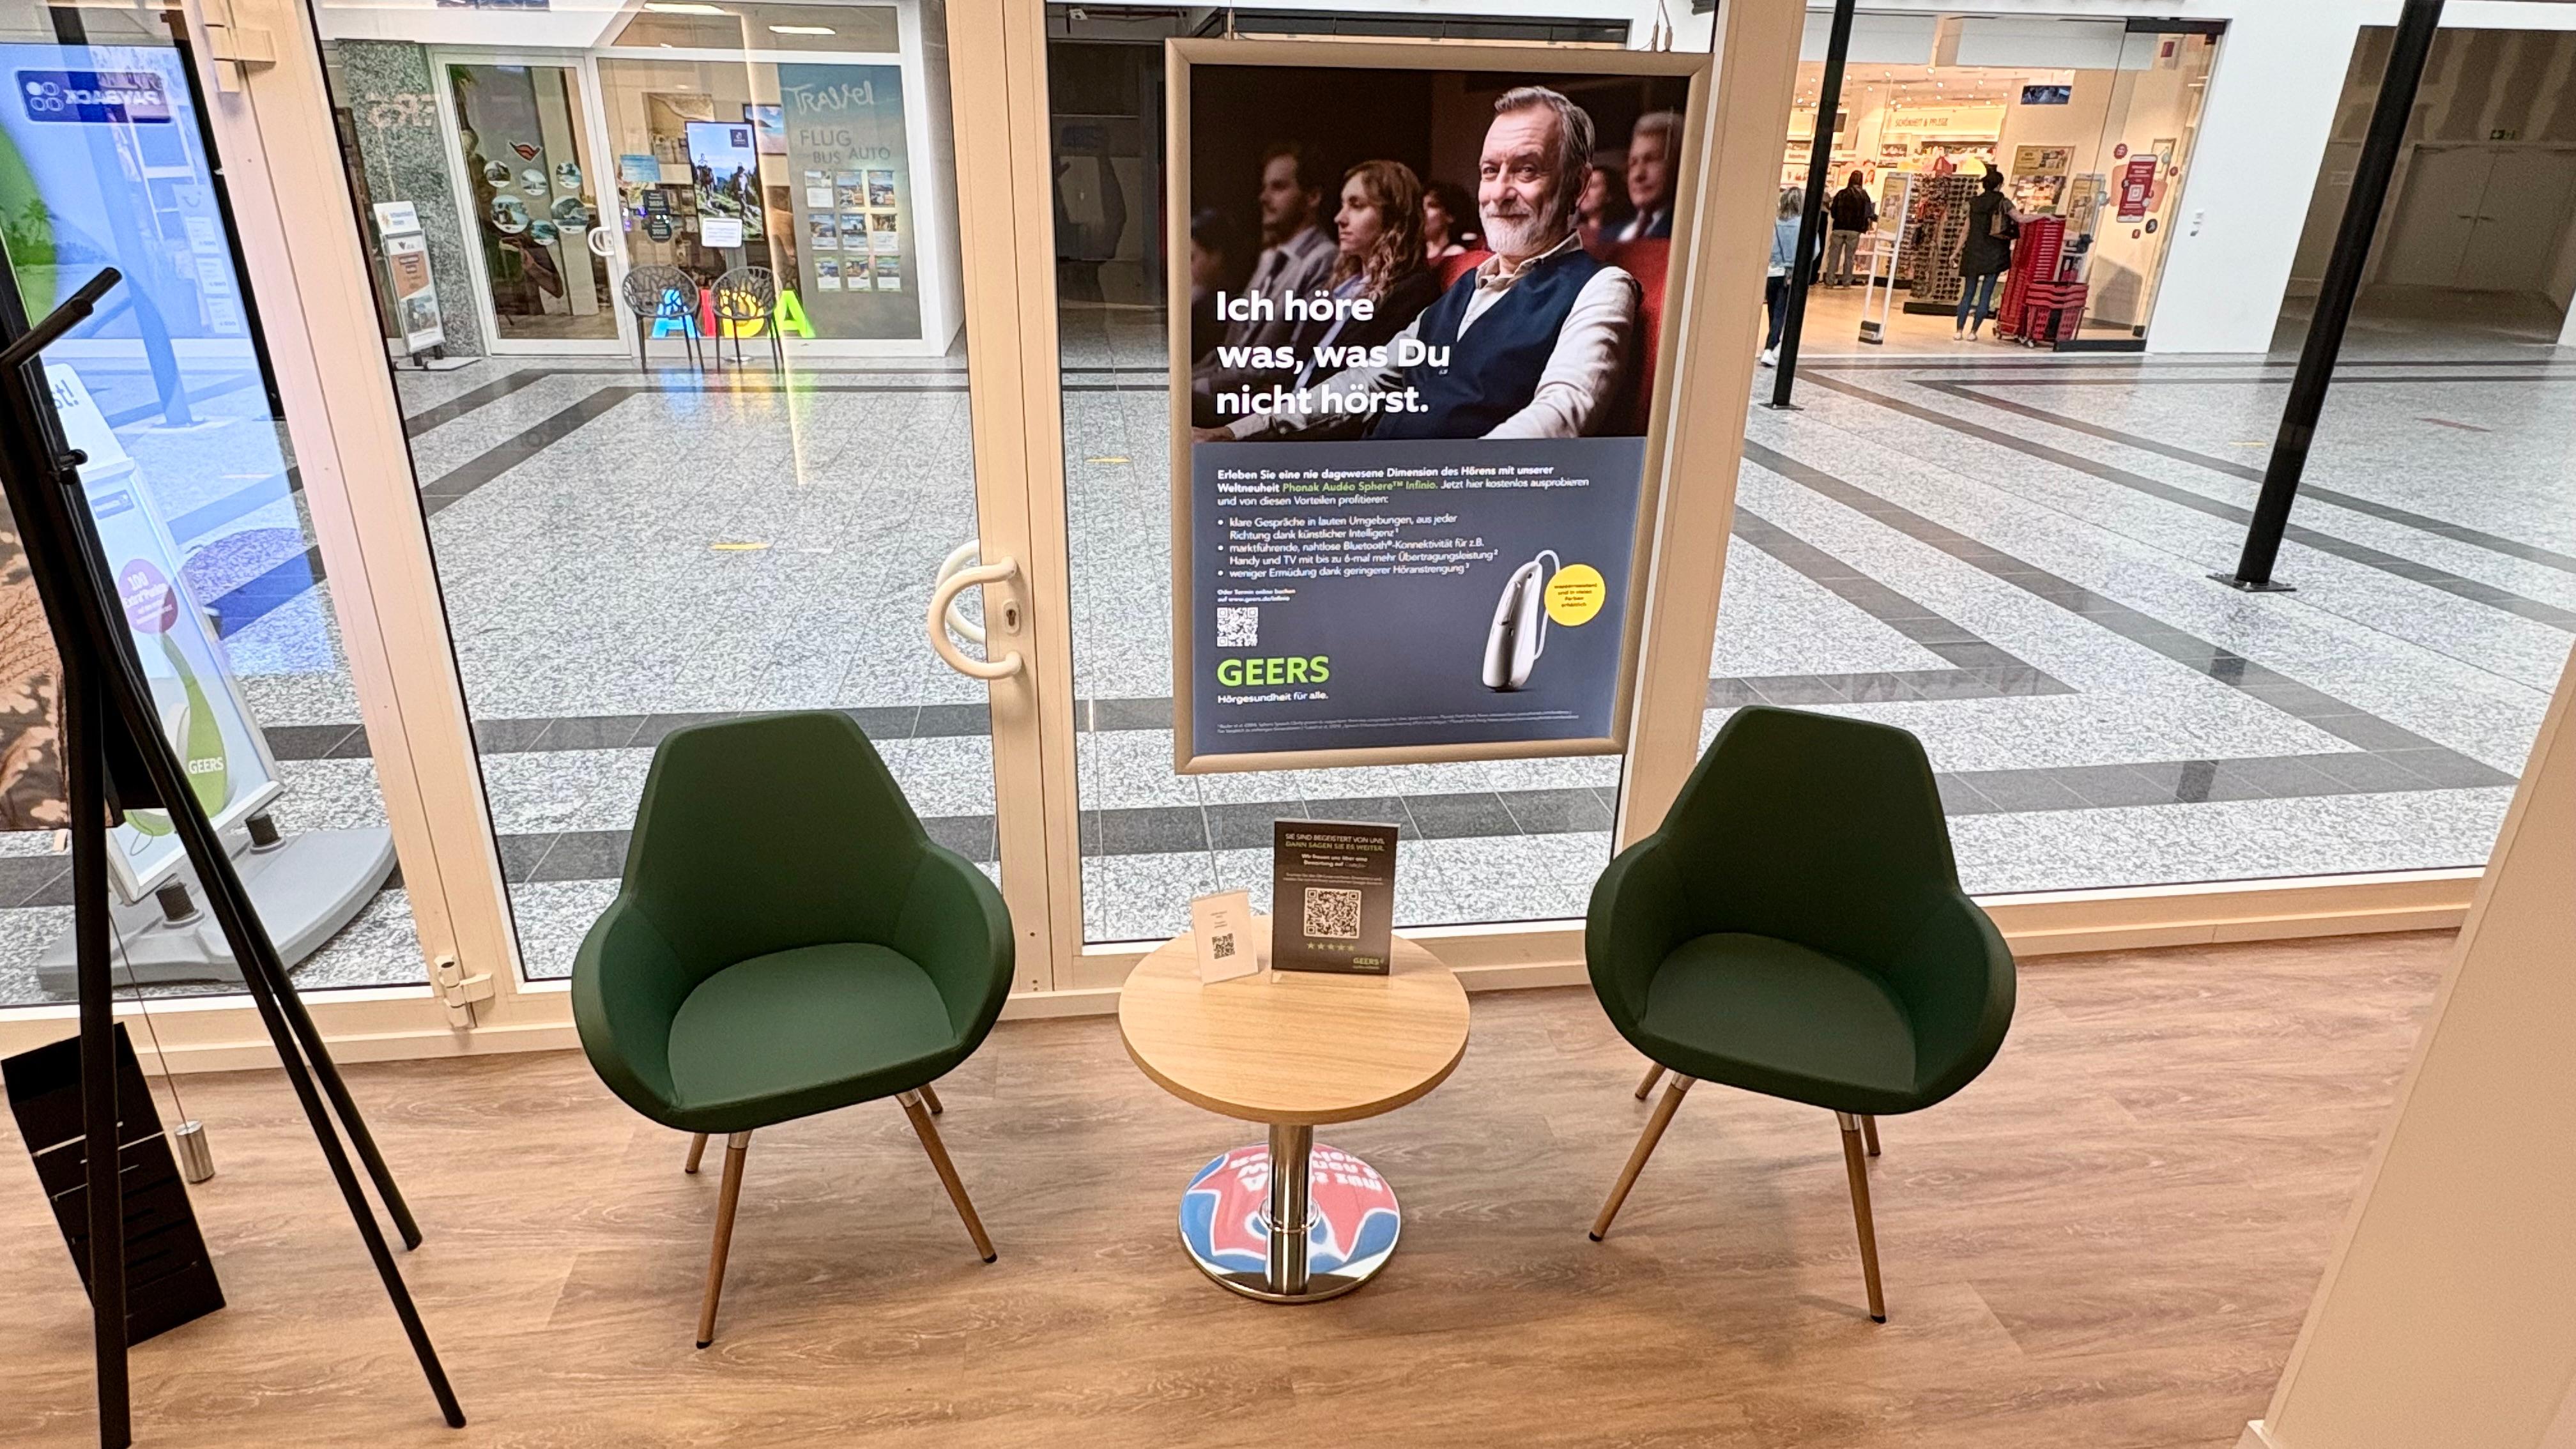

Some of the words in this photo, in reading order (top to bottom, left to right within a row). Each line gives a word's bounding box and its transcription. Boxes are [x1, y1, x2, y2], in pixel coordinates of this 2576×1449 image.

[800, 129, 852, 147] FLUG
[813, 151, 841, 164] BUS
[848, 148, 891, 160] AUTO
[1216, 289, 1274, 321] Ich
[1285, 290, 1375, 321] höre
[1217, 344, 1304, 375] was,
[1313, 345, 1389, 369] was
[1399, 338, 1450, 367] Du
[1216, 384, 1312, 415] nicht
[1321, 384, 1429, 414] hörst.
[1218, 470, 1257, 480] Erleben
[1260, 470, 1276, 479] Sie
[1278, 470, 1300, 479] eine
[1303, 470, 1318, 479] nie
[1321, 468, 1383, 480] dagewesene
[1387, 467, 1438, 477] Dimension
[1441, 467, 1458, 476] des
[1461, 466, 1496, 475] Hörens
[1498, 466, 1514, 475] mit
[1517, 466, 1554, 475] unserer
[1218, 483, 1280, 493] Weltneuheit
[1282, 482, 1319, 492] Phonak
[1322, 482, 1355, 491] Audéo
[1406, 480, 1438, 489] Infinio.
[1441, 480, 1463, 489] Jetzt
[1466, 479, 1483, 488] hier
[1485, 478, 1528, 487] kostenlos
[1530, 477, 1589, 490] ausprobieren
[1217, 496, 1236, 506] und
[1259, 496, 1291, 505] diesen
[1294, 496, 1336, 505] Vorteilen
[1338, 494, 1389, 507] profitieren:
[1230, 518, 1252, 527] klare
[1254, 517, 1305, 529] Gespräche
[1308, 517, 1315, 526] in
[1318, 517, 1346, 526] lauten
[1349, 515, 1414, 526] Umgebungen,
[1416, 516, 1432, 524] aus
[1433, 514, 1457, 525] jeder
[1230, 530, 1270, 542] Richtung
[1273, 530, 1295, 539] dank
[1298, 529, 1346, 539] künstlicher
[1230, 543, 1300, 553] marktführende,
[1303, 542, 1340, 551] nahtlose
[1455, 539, 1468, 548] für
[1469, 538, 1484, 547] z.B.
[1230, 556, 1260, 567] Handy
[1262, 556, 1281, 565] und
[1283, 556, 1296, 564] TV
[1299, 555, 1313, 564] mit
[1315, 555, 1329, 564] bis
[1344, 555, 1370, 563] 6-mal
[1372, 553, 1395, 562] mehr
[1230, 569, 1266, 580] weniger
[1269, 568, 1317, 578] Ermüdung
[1319, 567, 1341, 576] dank
[1344, 566, 1390, 578] geringerer
[1217, 656, 1330, 686] GEERS
[1218, 693, 1291, 704] Hörgesundheit
[1293, 691, 1307, 701] für
[1310, 691, 1329, 700] alle.
[189, 756, 224, 774] GEERS
[1314, 834, 1351, 843] BEGEISTERT
